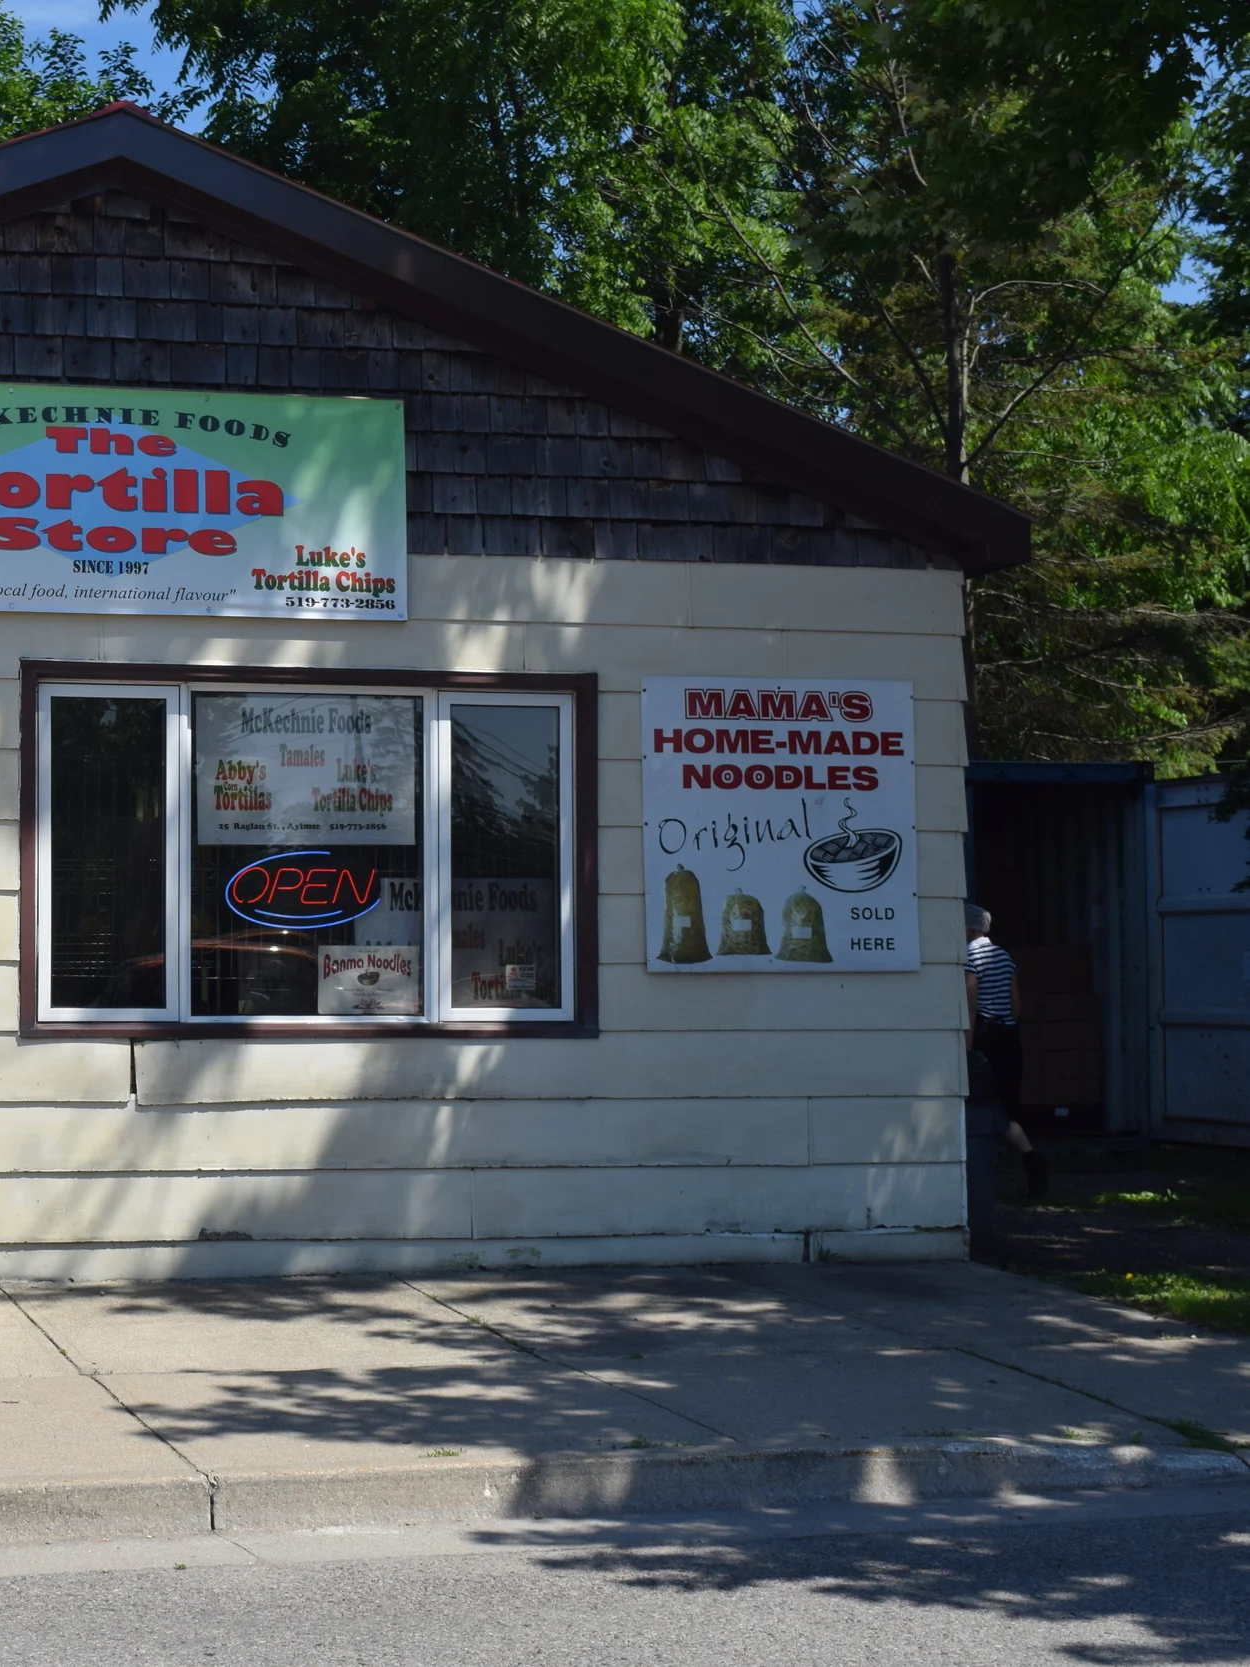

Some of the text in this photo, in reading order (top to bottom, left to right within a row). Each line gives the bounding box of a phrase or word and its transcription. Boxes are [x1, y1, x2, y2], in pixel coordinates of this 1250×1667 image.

[45, 425, 178, 457] The
[174, 410, 292, 449] FOODS
[72, 559, 150, 575] SINCE 1997
[294, 544, 366, 569] Luke's
[28, 583, 68, 601] food,
[73, 585, 171, 601] international
[251, 568, 396, 598] Tortilla Chips
[285, 596, 396, 610] 519-773-2856
[683, 688, 873, 723] MAMA'S
[240, 706, 372, 734] McKechnie Foods
[279, 743, 326, 768] Tamales
[653, 728, 905, 757] HOME-MADE
[214, 758, 267, 784] Abby's
[336, 757, 378, 783] Luke's
[682, 764, 879, 792] NOODLES
[213, 784, 273, 811] Tortillas
[312, 787, 393, 817] Tortilla Chips
[218, 822, 229, 830] 25
[233, 822, 265, 831] Raglan
[287, 822, 321, 831] Aylmer
[329, 823, 387, 831] 519-773-2856
[658, 798, 814, 872] Original
[232, 866, 377, 905] OPEN
[850, 907, 895, 921] SOLD
[850, 937, 896, 951] HERE
[323, 953, 412, 979] Banma Noodles
